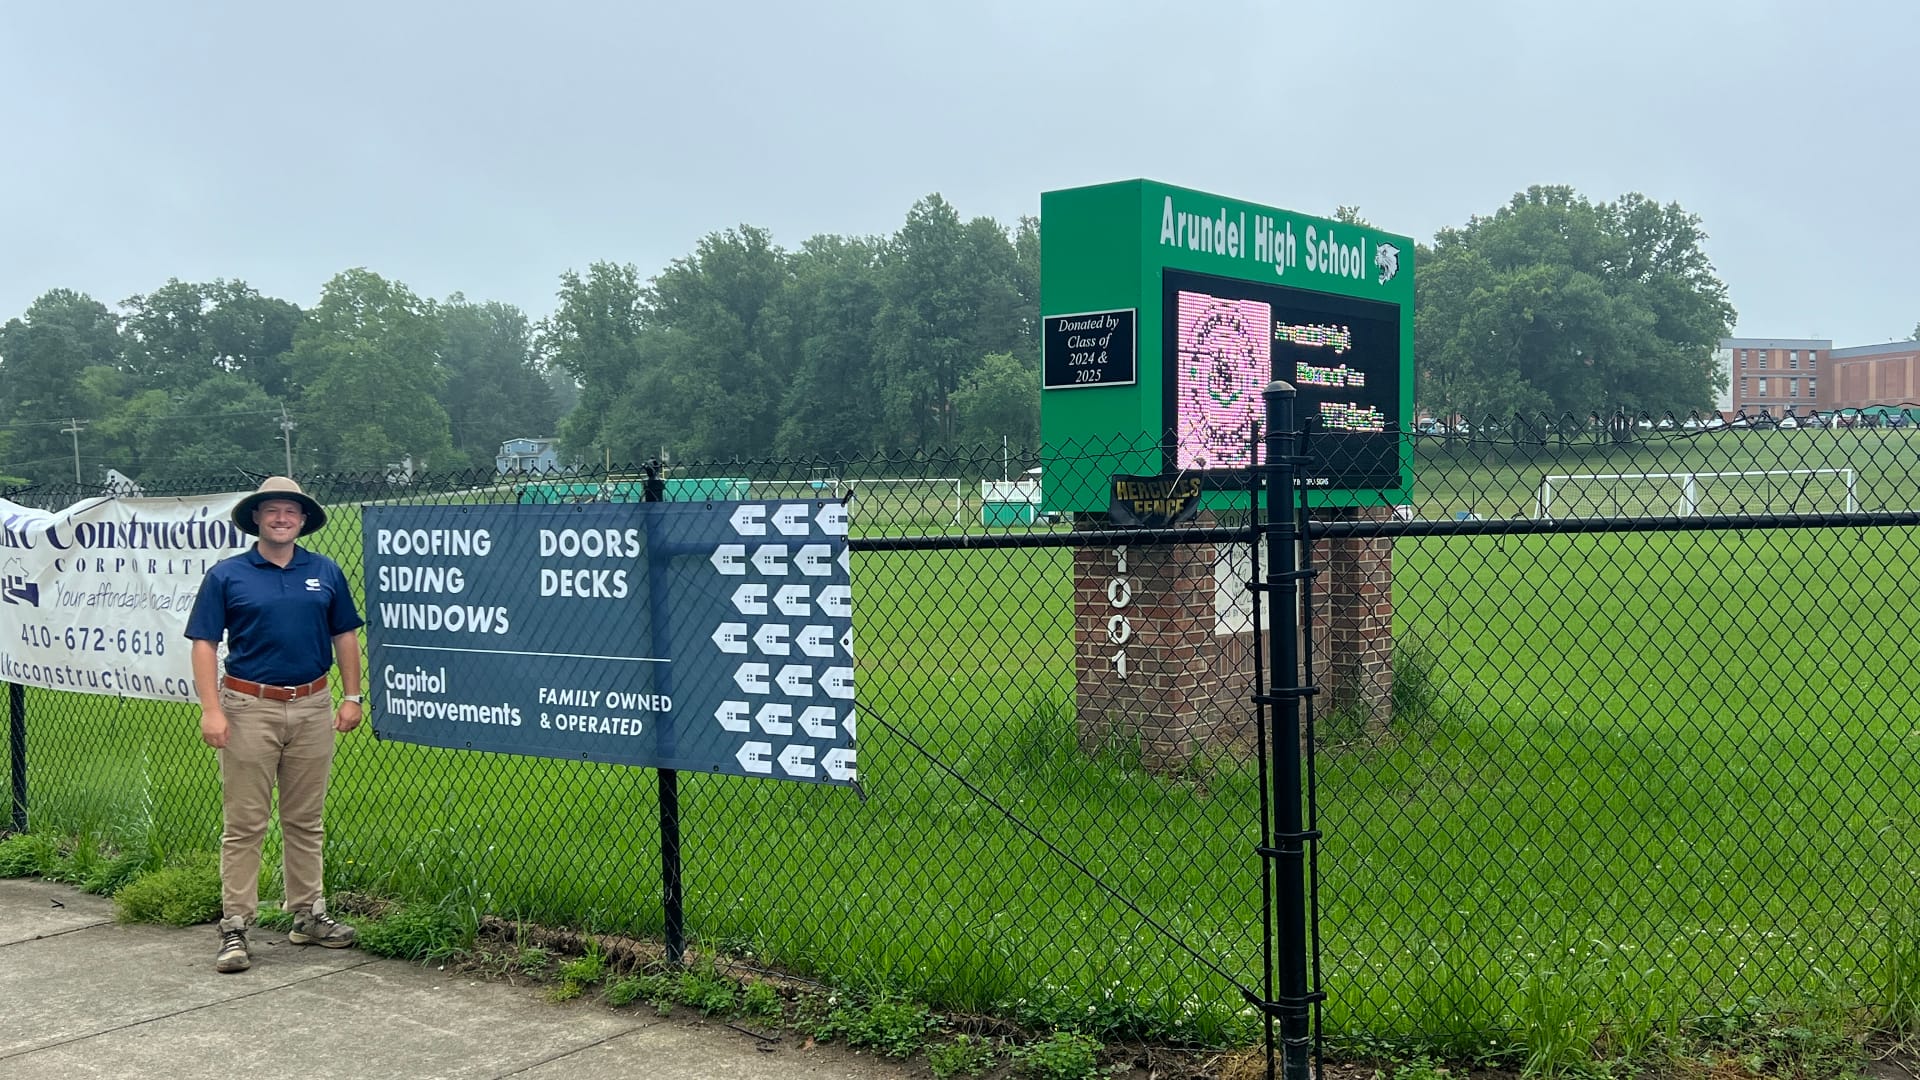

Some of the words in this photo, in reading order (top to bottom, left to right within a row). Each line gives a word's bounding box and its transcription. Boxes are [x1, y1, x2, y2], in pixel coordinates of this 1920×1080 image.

[1160, 196, 1245, 258] Arundel
[1255, 214, 1296, 275] High
[1305, 224, 1366, 280] School
[1058, 315, 1105, 332] Donated
[1106, 315, 1119, 331] by
[1067, 335, 1097, 349] Class
[1098, 332, 1113, 349] of
[1068, 351, 1095, 366] 2024
[1097, 350, 1108, 364] &
[1075, 369, 1102, 382] 2025
[46, 506, 246, 550] Construction
[377, 529, 491, 556] ROOFING
[539, 528, 640, 557] DOORS
[55, 558, 223, 575] CORPORATI
[379, 566, 464, 593] SIDING
[55, 580, 86, 608] Your
[540, 569, 628, 598] DECKS
[380, 602, 509, 634] WINDOWS
[384, 664, 446, 697] Capitol
[386, 690, 522, 727] Improvements
[538, 687, 600, 708] FAMILY
[605, 690, 672, 712] OWNED
[540, 712, 551, 729] &
[555, 713, 643, 735] OPERATED
